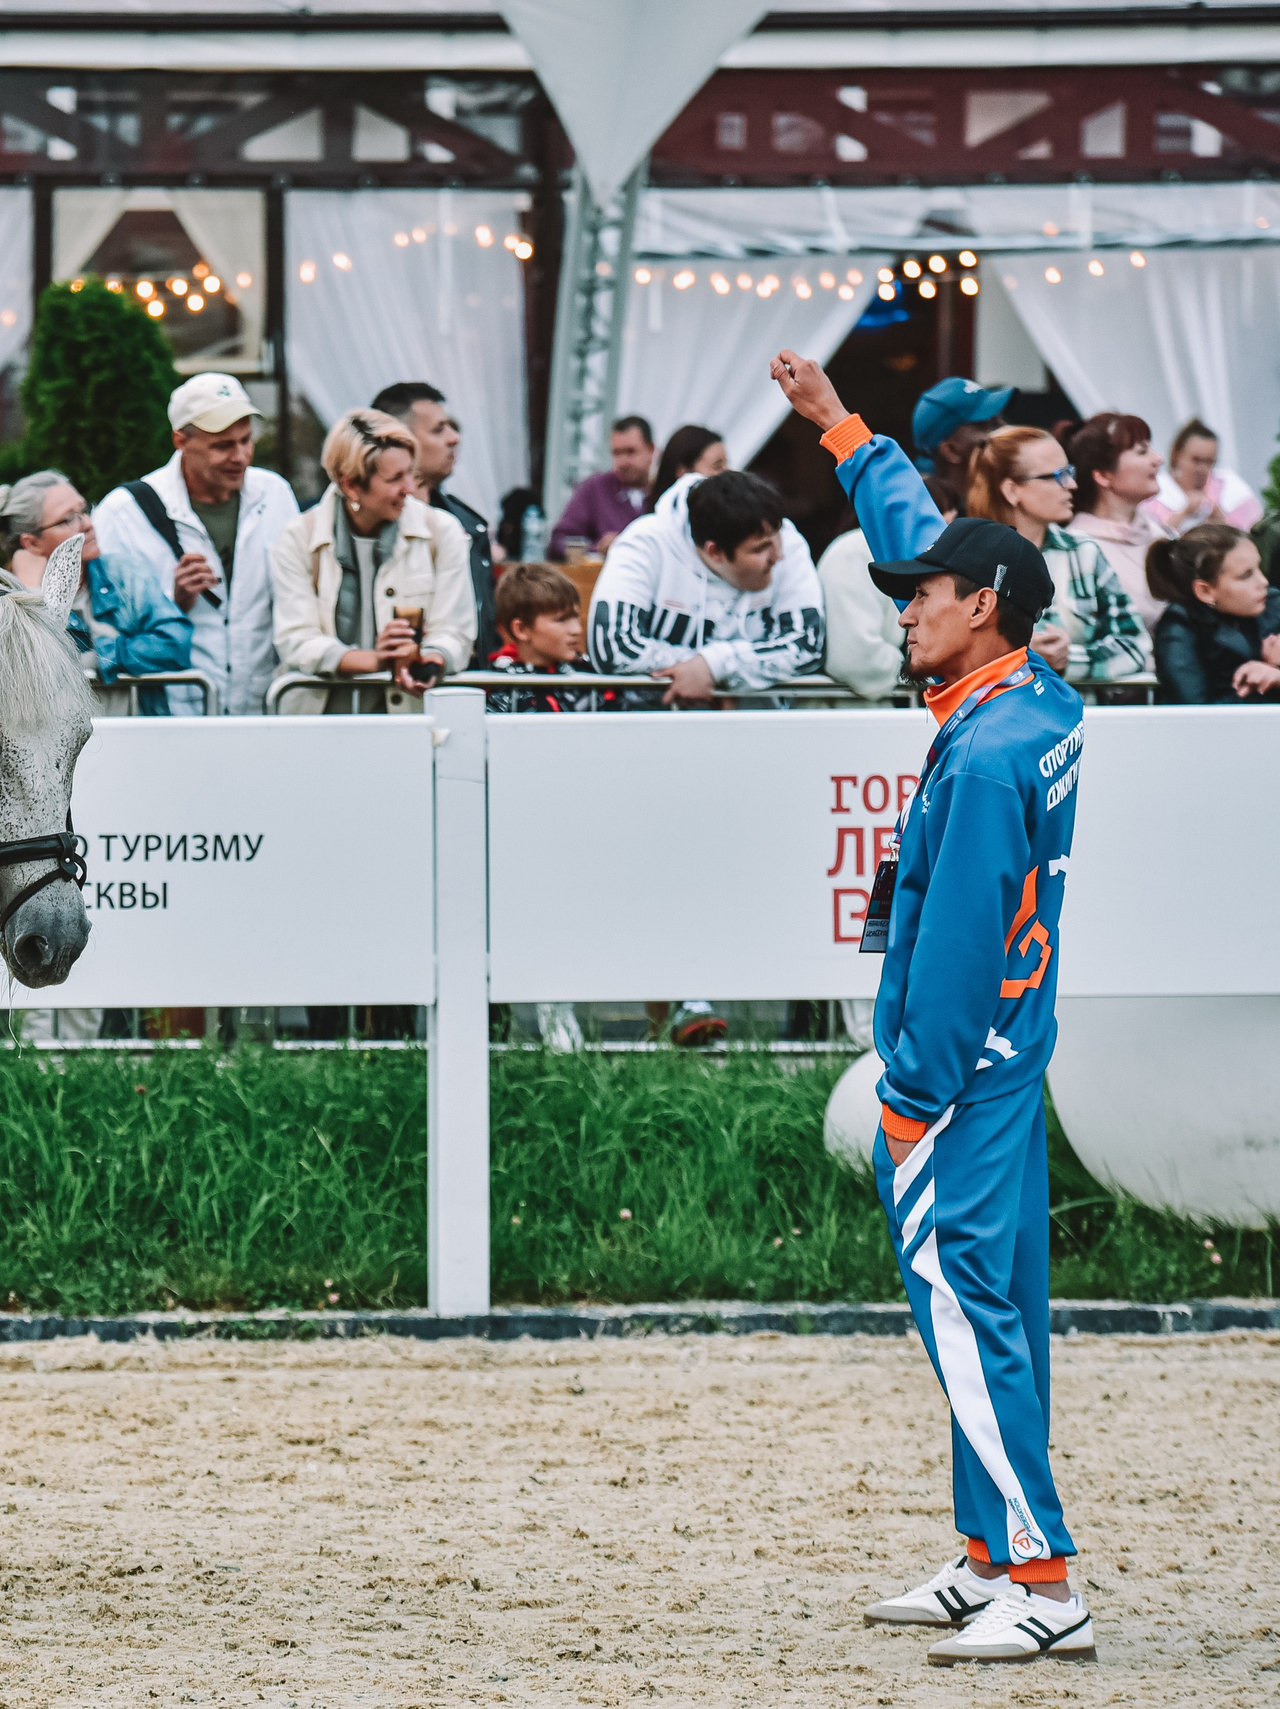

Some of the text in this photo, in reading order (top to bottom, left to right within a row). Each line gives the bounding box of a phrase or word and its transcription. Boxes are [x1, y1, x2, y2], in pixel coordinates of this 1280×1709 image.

[829, 774, 921, 814] ГОР
[98, 834, 264, 862] ТУРИЗМУ
[826, 827, 895, 877] ЛЕ
[84, 881, 168, 910] КВЫ
